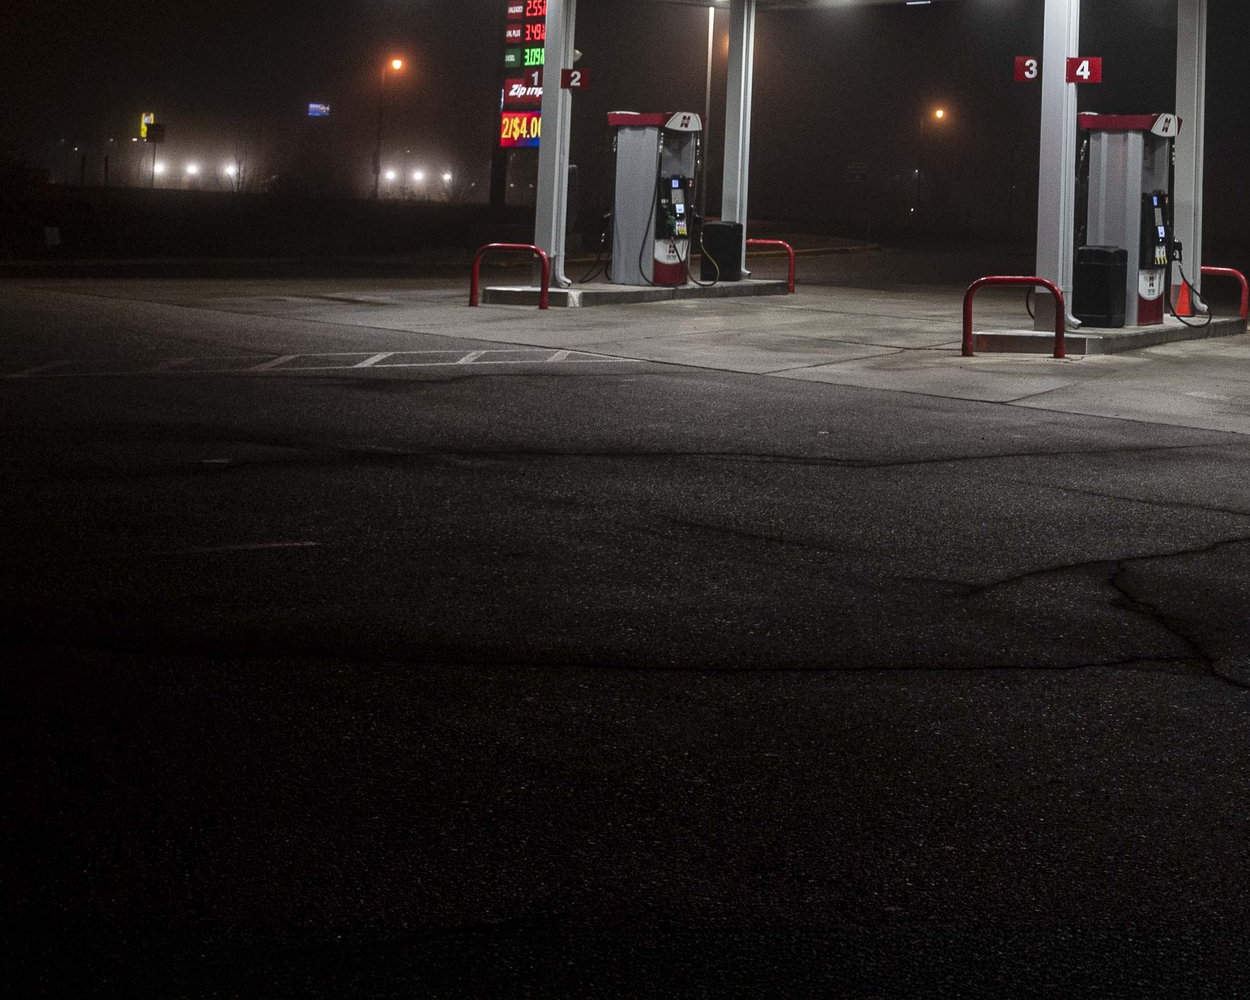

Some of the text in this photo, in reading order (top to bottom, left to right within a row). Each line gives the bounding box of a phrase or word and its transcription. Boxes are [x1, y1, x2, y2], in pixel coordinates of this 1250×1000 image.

[1024, 59, 1038, 79] 3
[1075, 60, 1091, 80] 4
[531, 71, 539, 86] 1
[570, 71, 581, 87] 2
[508, 83, 526, 98] Zip
